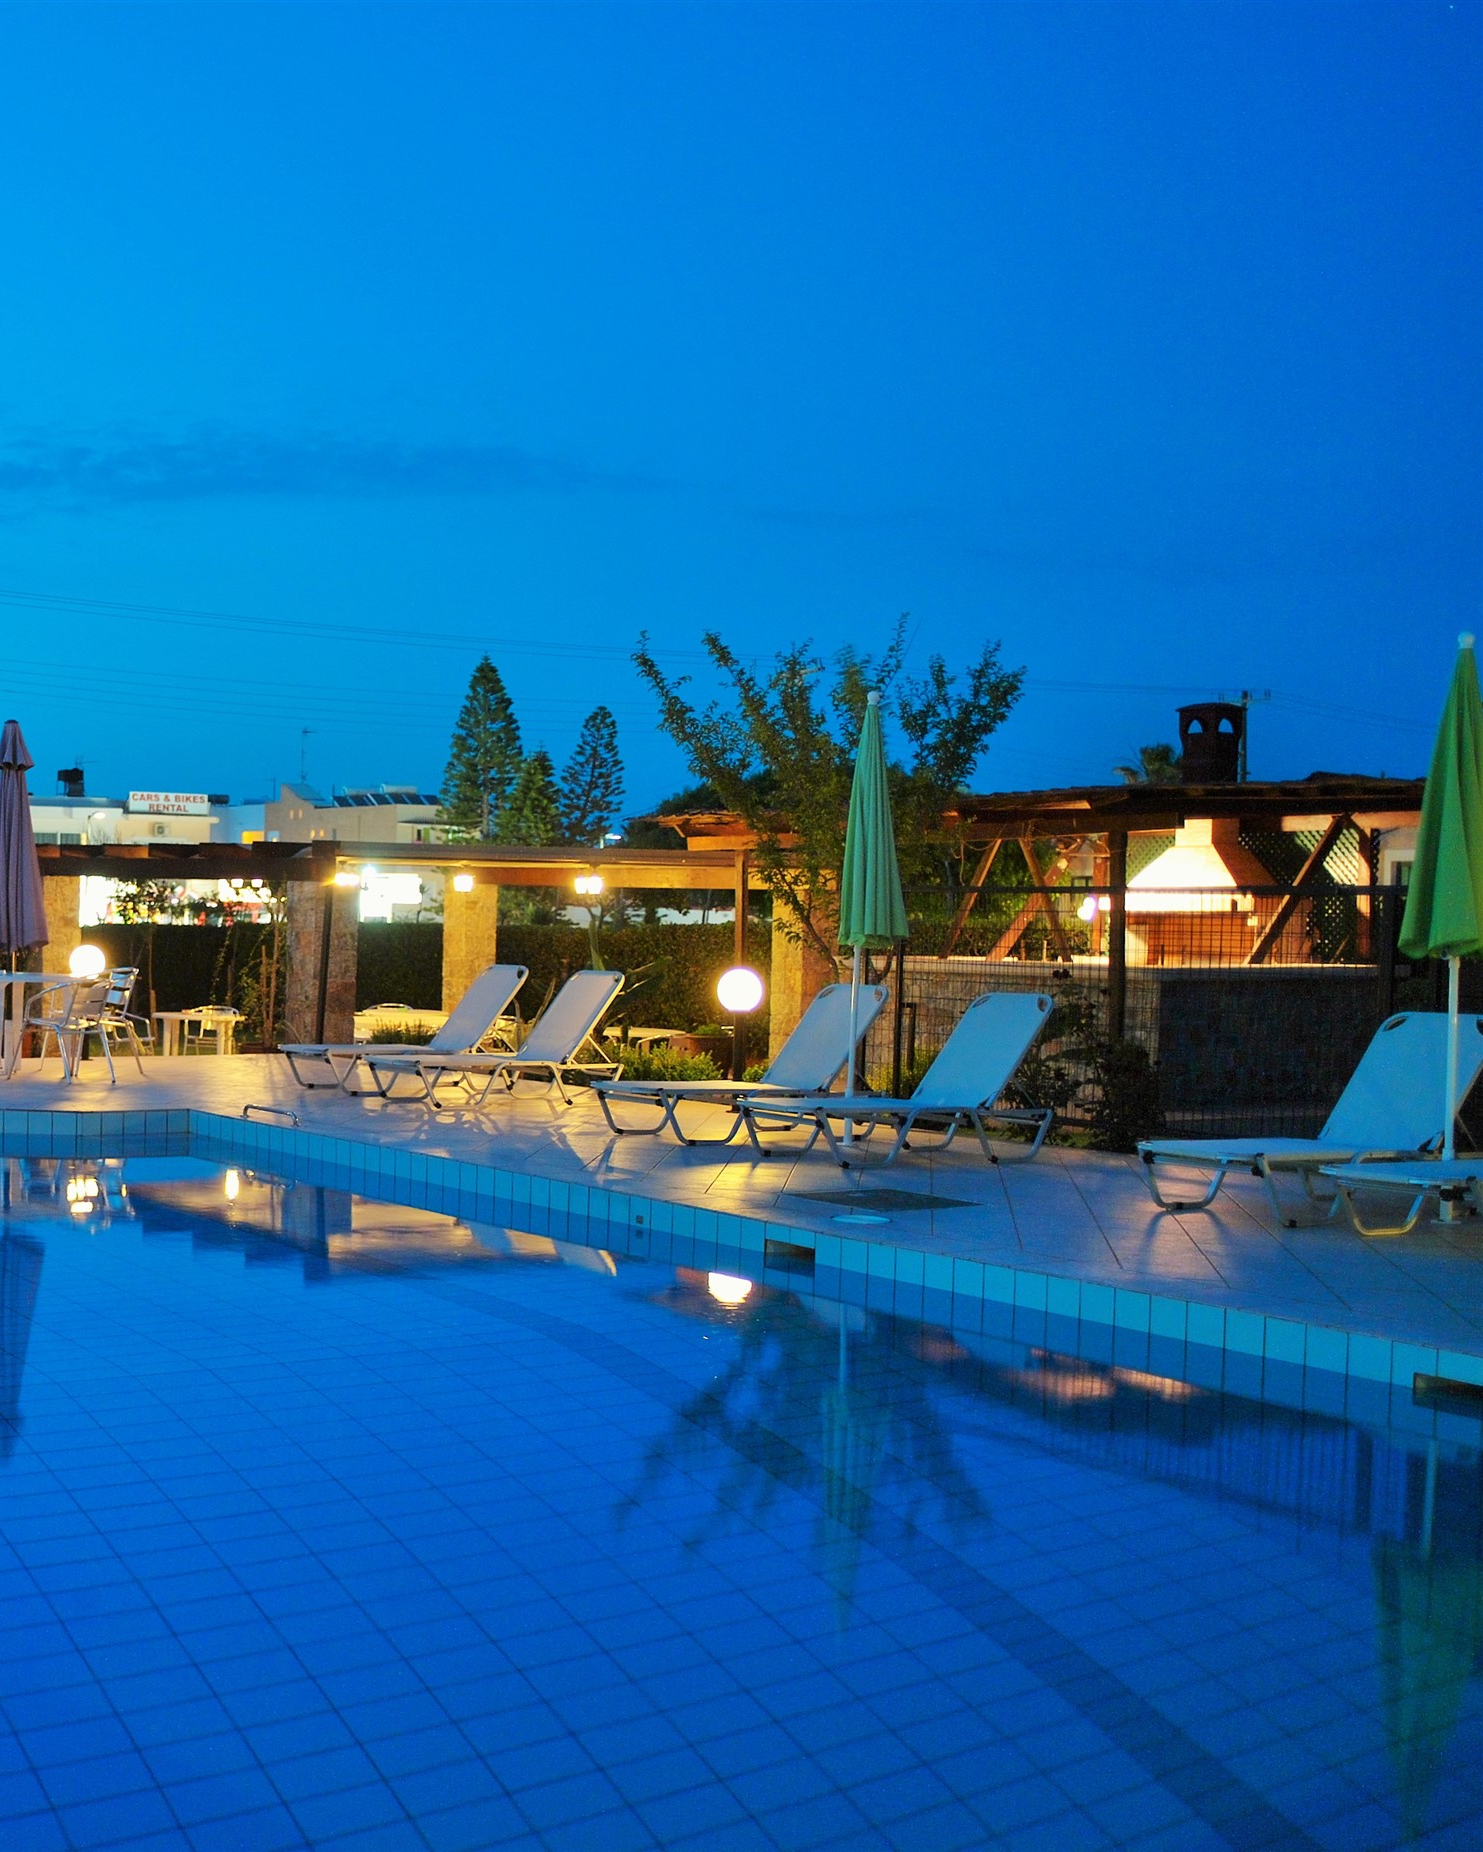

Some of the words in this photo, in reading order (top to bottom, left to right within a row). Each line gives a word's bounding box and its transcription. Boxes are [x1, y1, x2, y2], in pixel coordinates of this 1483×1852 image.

[132, 793, 160, 802] CARS
[163, 794, 171, 802] &
[174, 794, 206, 804] BIKES
[149, 803, 189, 812] RENTAL
